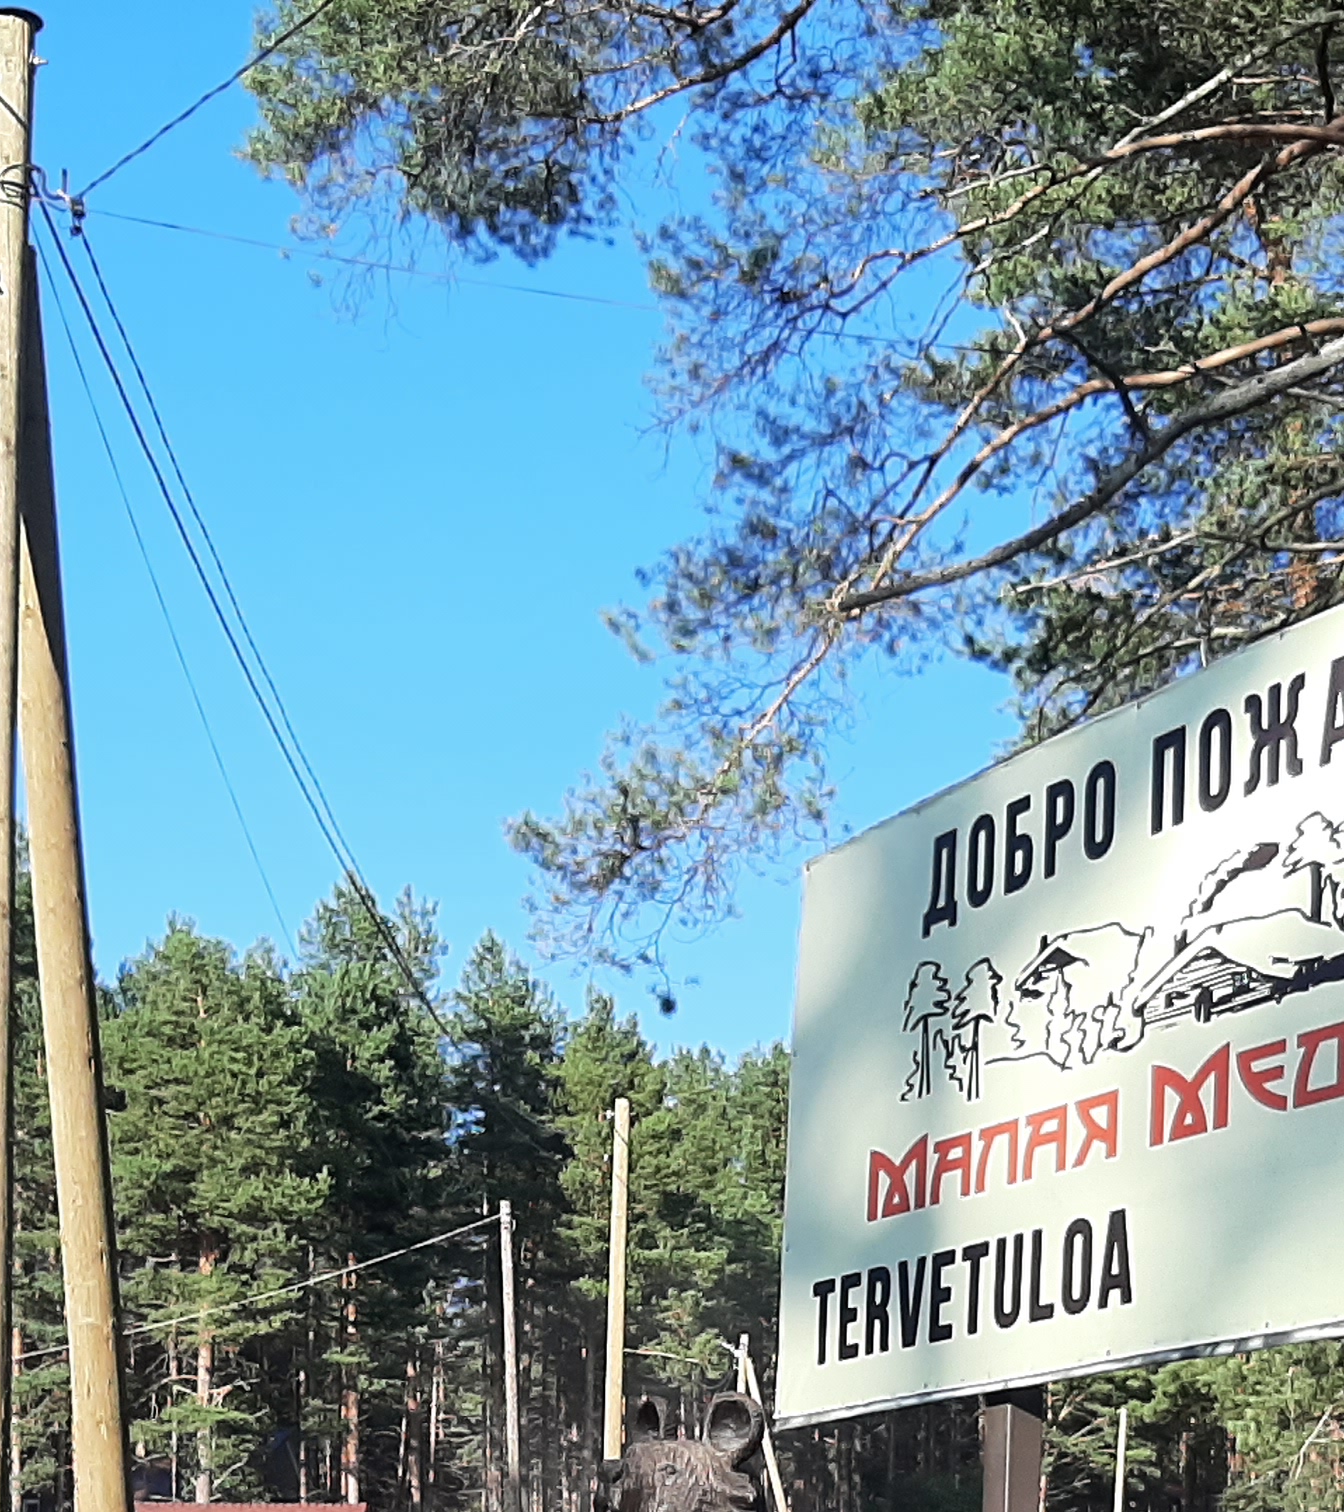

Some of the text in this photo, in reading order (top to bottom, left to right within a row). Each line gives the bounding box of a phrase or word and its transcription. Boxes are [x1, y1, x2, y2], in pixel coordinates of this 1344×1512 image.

[922, 759, 1117, 940] ДОБРО
[869, 1091, 1120, 1220] МАЛАЯ
[812, 1208, 1133, 1366] TERVETULOA
